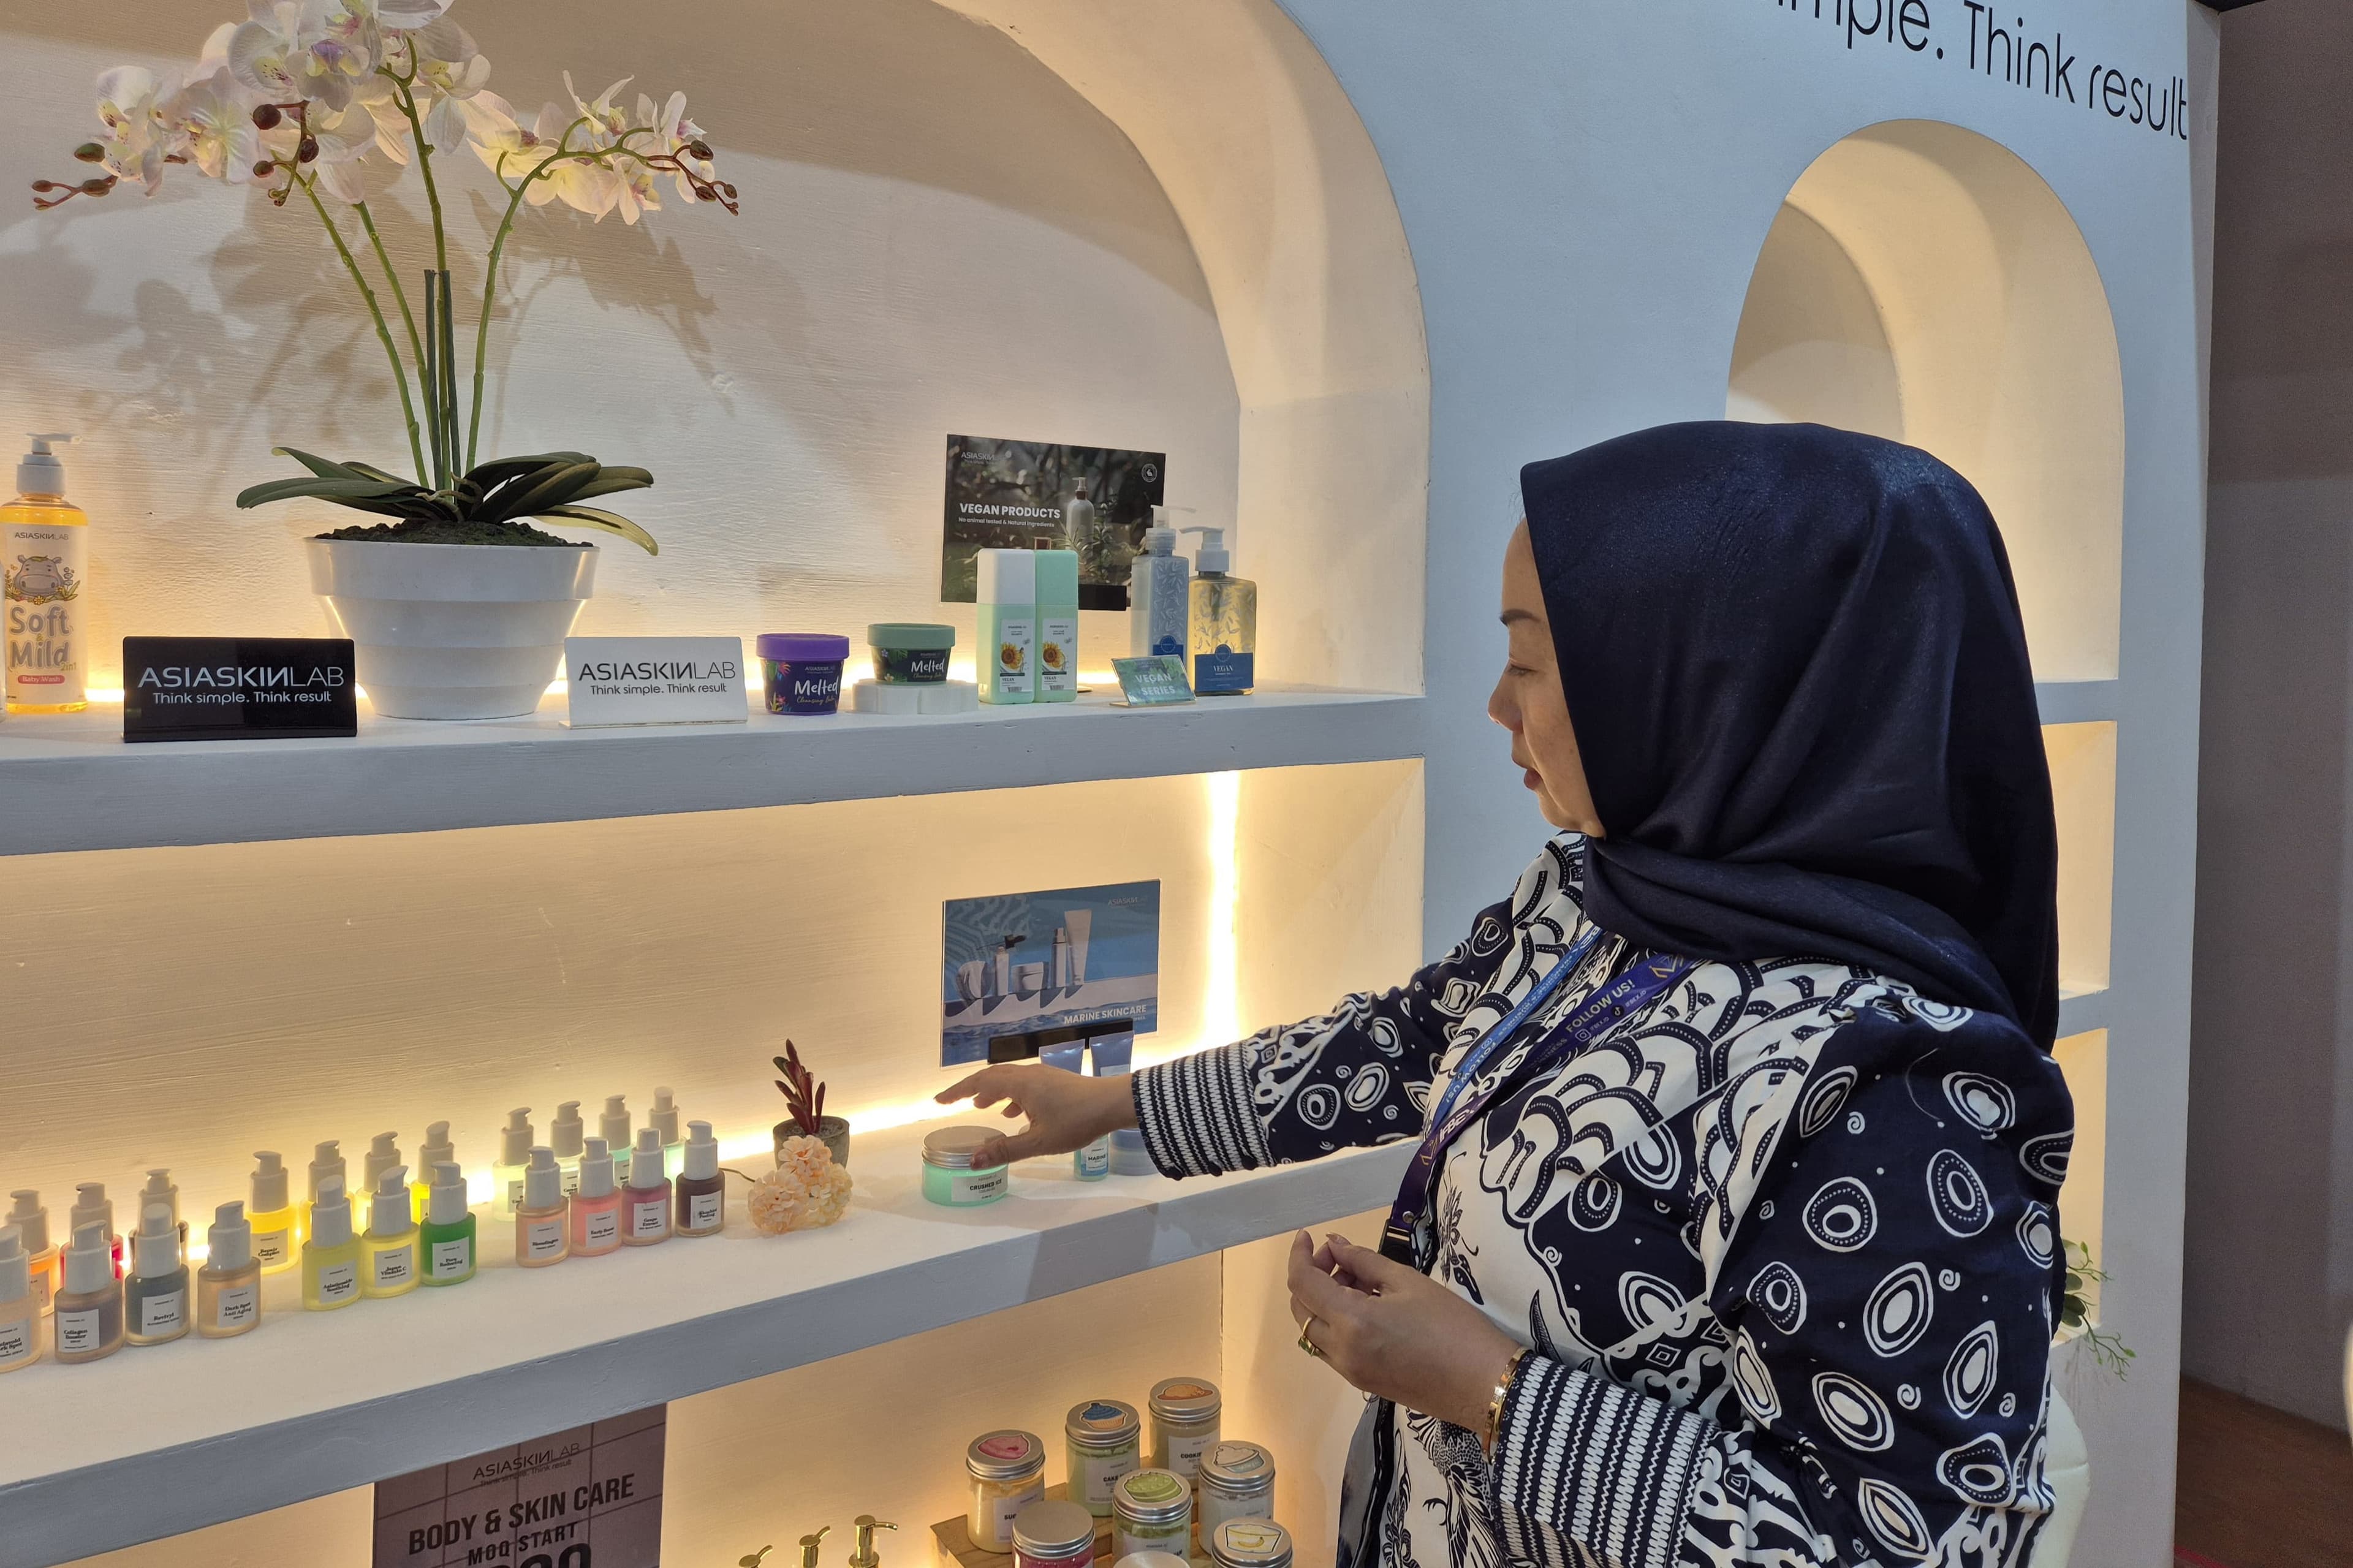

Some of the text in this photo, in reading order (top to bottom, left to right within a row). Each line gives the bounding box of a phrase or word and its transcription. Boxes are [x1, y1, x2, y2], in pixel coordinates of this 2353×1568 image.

[1964, 0, 2075, 104] Think
[2089, 64, 2188, 140] result
[960, 503, 1061, 518] VEGAN PRODUCTS
[10, 605, 70, 637] Soft
[36, 633, 44, 642] &
[11, 642, 70, 668] Mild
[61, 662, 77, 671] 2in1
[578, 662, 736, 681] ASIASKINLAB
[911, 657, 945, 673] Melted
[137, 667, 344, 688] ASIASKINLAB
[794, 676, 839, 695] Melted
[1135, 673, 1172, 683] VEGAN
[153, 691, 332, 706] Think simple. Think result
[591, 683, 727, 696] Think simple. Think result
[1140, 686, 1176, 695] SERIES
[1064, 1005, 1147, 1025] MARINE SKINCARE
[1566, 979, 1635, 1032] FOLLOW US!
[1461, 1042, 1496, 1084] FOLLOW
[969, 1181, 995, 1191] CRUSHED
[409, 1472, 635, 1555] BODY & SKIN CARE
[468, 1540, 510, 1566] MOQ
[518, 1521, 578, 1551] START
